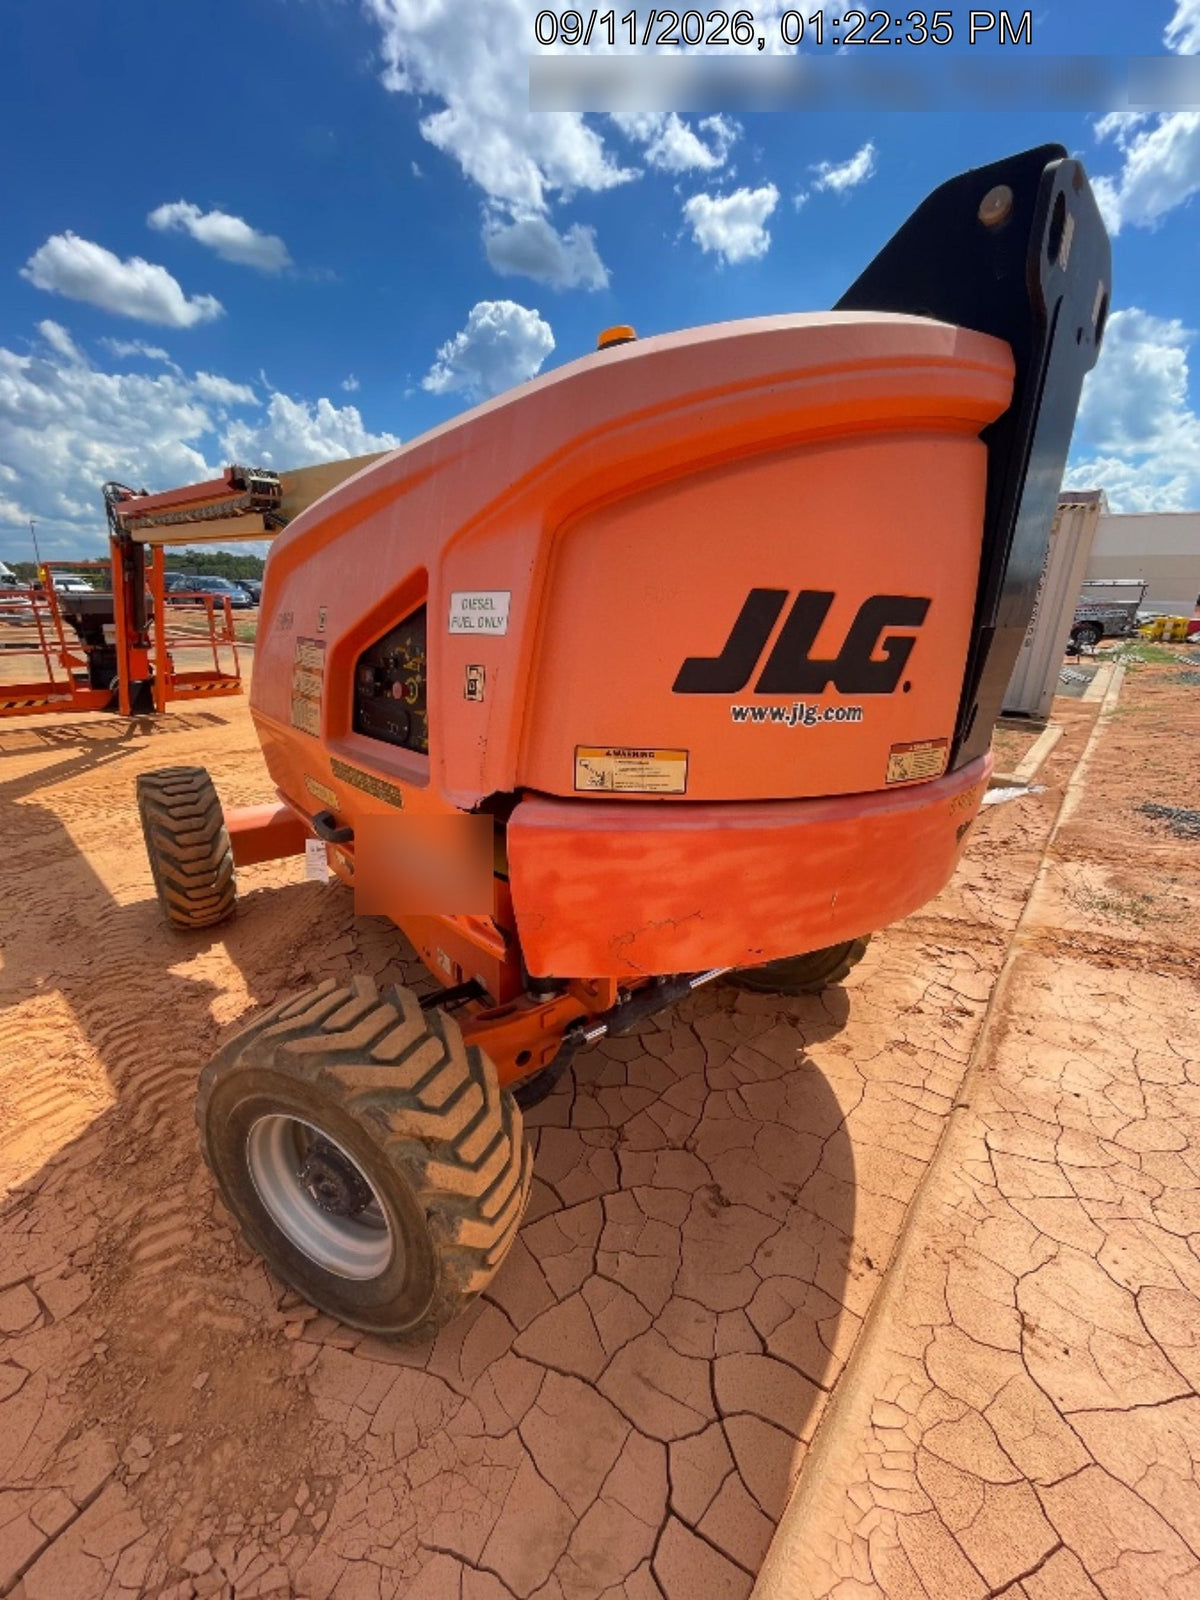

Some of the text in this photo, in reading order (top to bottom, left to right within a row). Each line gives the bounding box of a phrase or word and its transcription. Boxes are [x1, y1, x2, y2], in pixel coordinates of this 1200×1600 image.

[461, 598, 495, 611] DIESEL
[451, 616, 504, 629] FUEL ONLY
[731, 702, 863, 727] www.jlg.com
